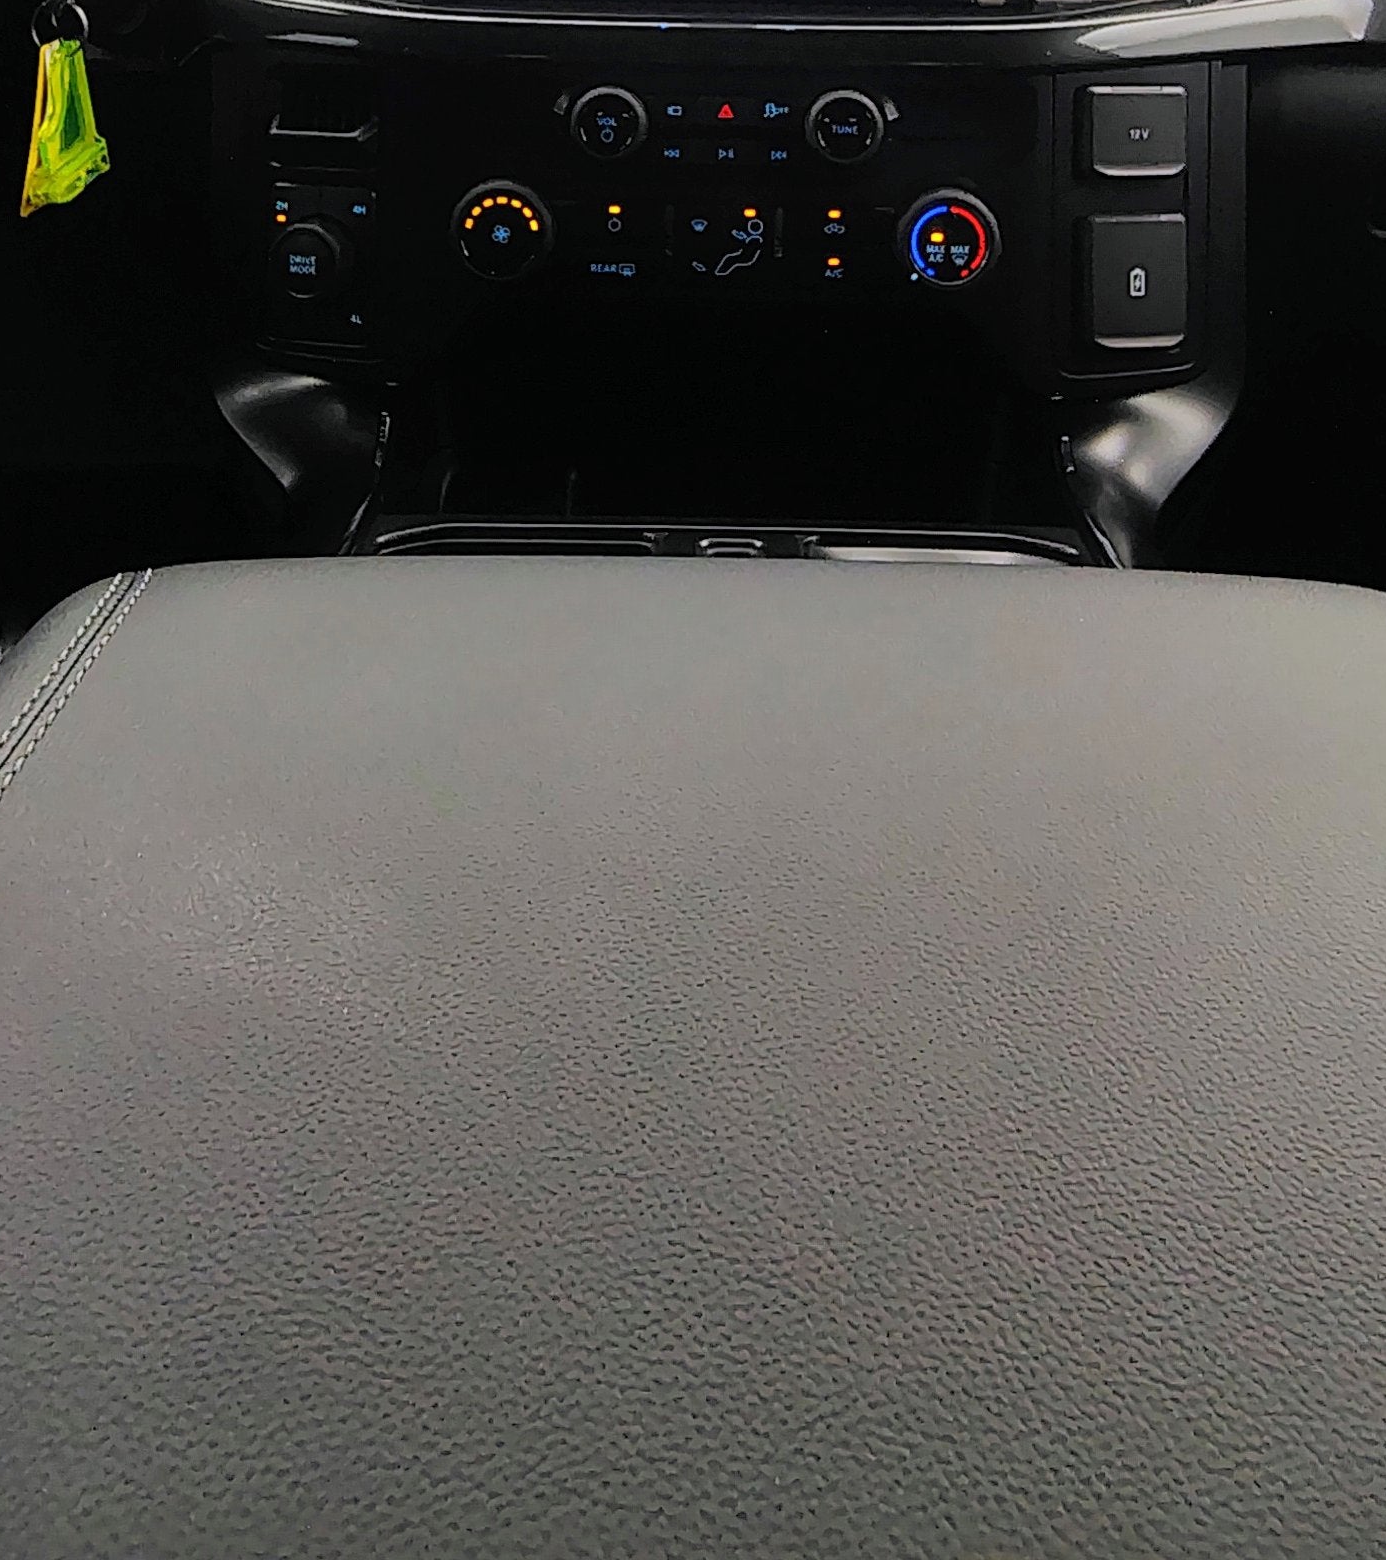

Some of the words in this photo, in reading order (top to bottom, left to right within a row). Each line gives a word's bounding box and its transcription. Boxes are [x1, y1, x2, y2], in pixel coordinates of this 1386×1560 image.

[597, 117, 617, 128] VOL
[830, 124, 859, 135] TUNE
[1128, 127, 1150, 140] 12V
[926, 244, 946, 254] MAX
[950, 245, 970, 254] MAX
[289, 254, 317, 265] DRIVE
[289, 265, 317, 275] MODE
[590, 263, 618, 273] REAR
